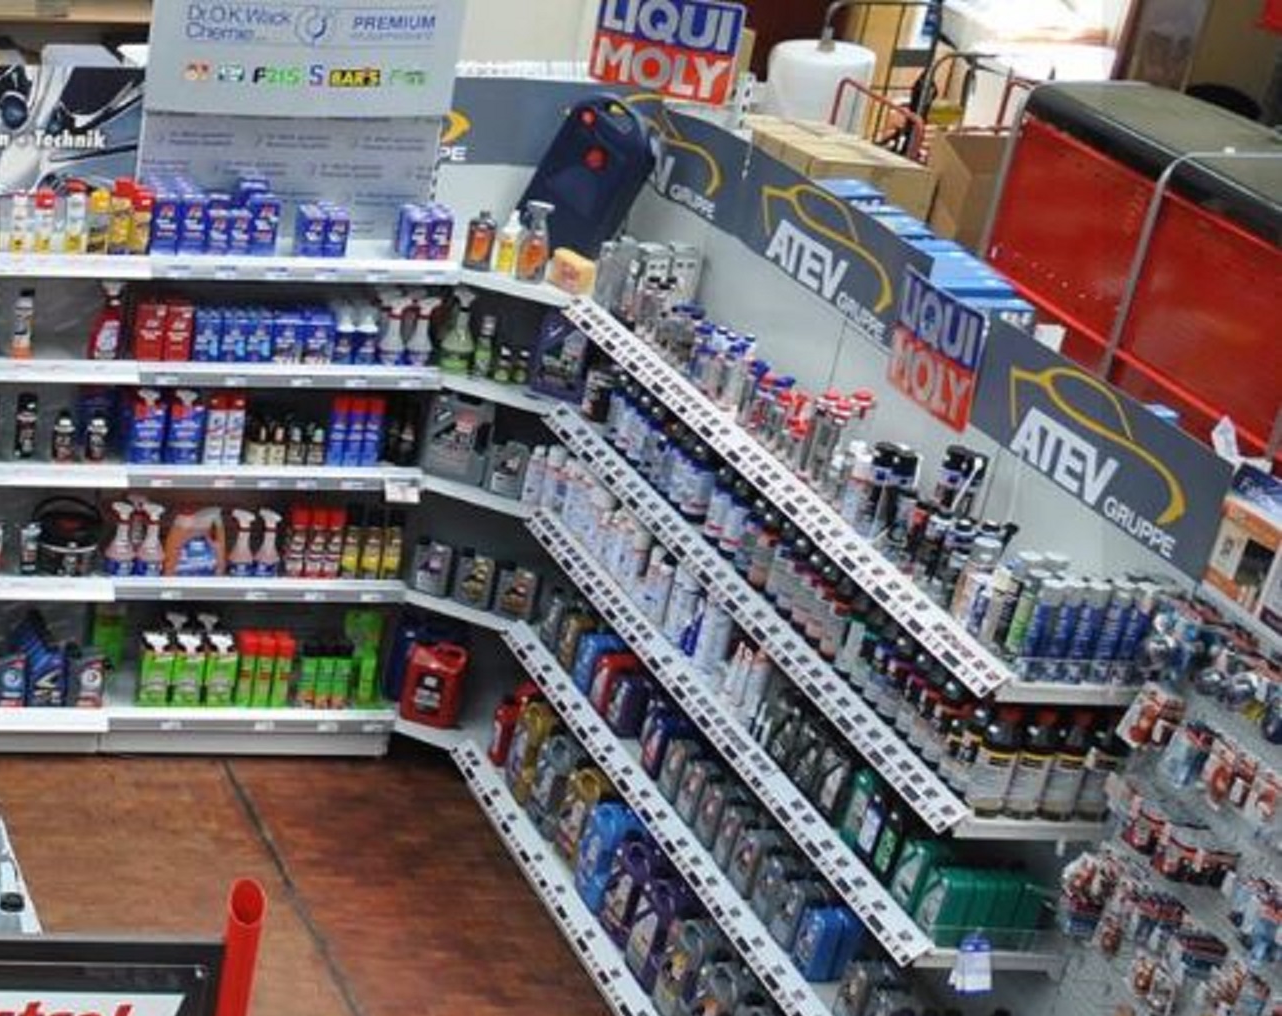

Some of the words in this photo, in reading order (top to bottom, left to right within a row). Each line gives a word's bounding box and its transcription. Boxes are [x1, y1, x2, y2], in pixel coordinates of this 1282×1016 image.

[352, 15, 436, 31] PREMIUM
[601, 0, 736, 53] LIQUI
[592, 36, 730, 106] MOLY
[34, 130, 106, 149] Technik
[765, 219, 850, 299] ATEV
[899, 275, 981, 370] LIQUI
[890, 328, 972, 425] MOLY
[1009, 405, 1121, 506] ATEV
[1101, 496, 1177, 560] GRUPPE
